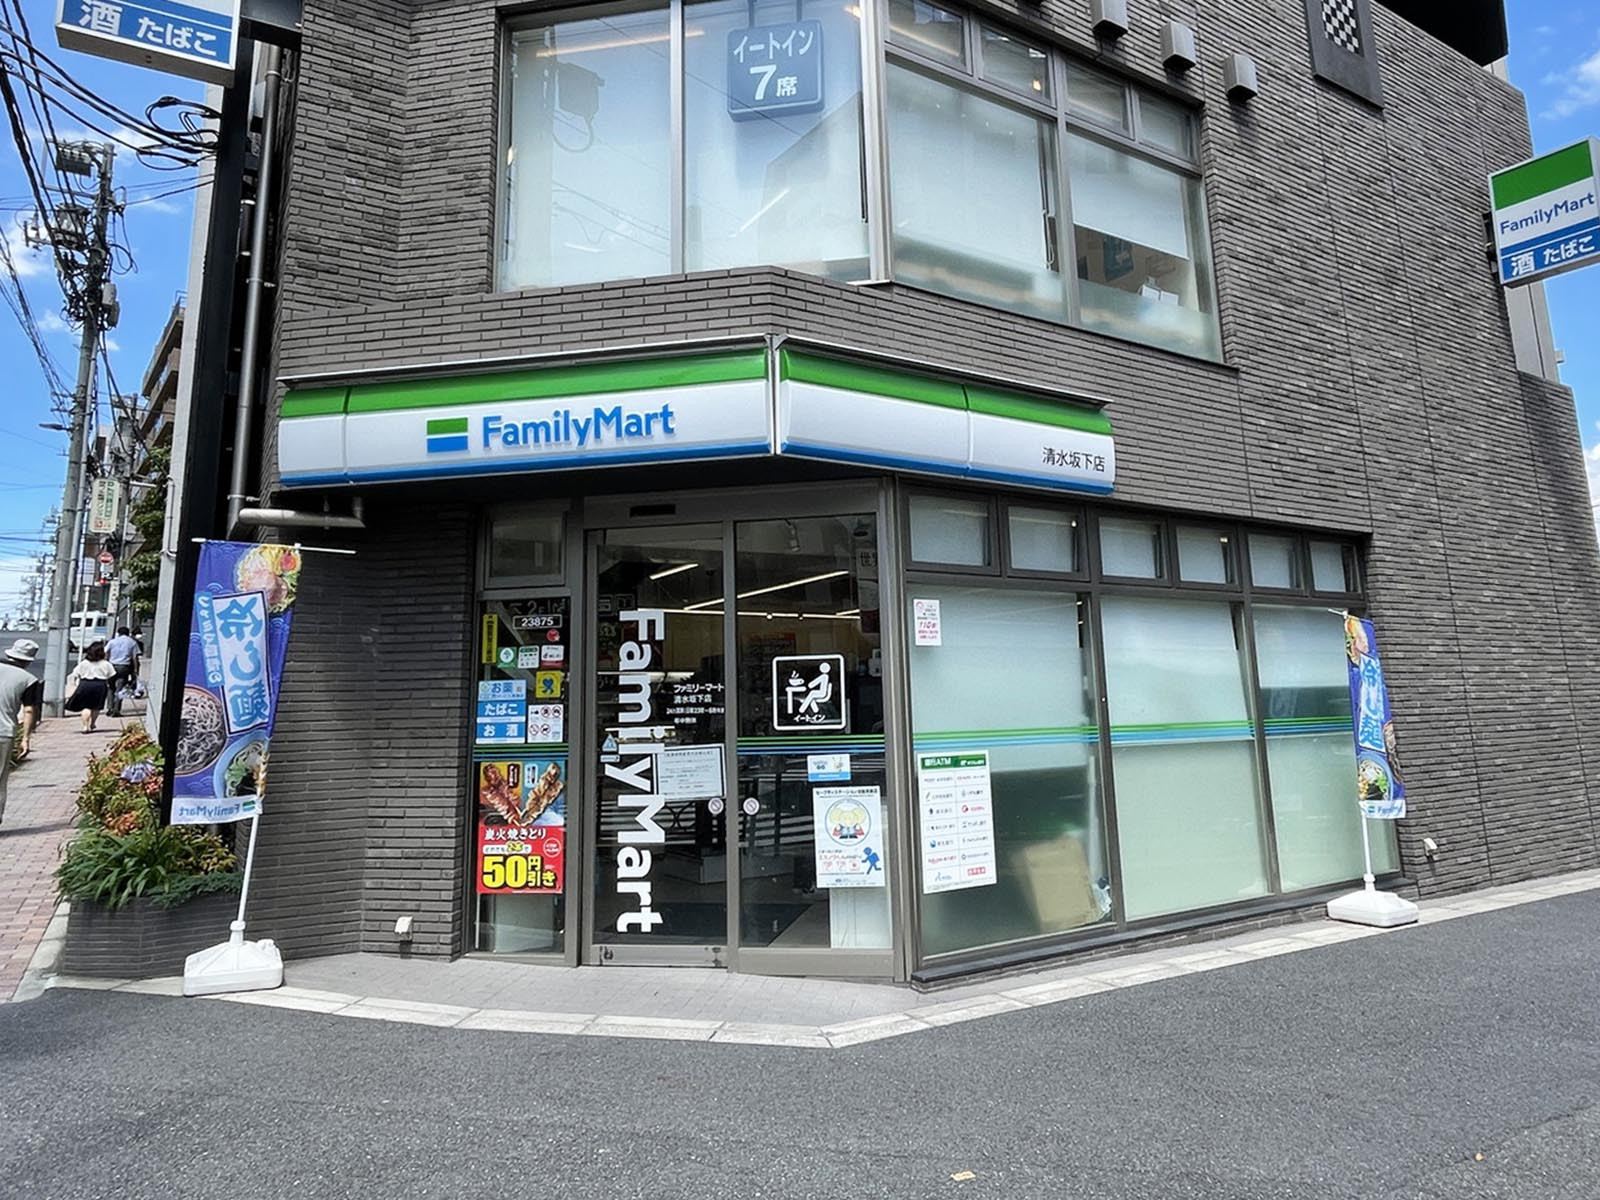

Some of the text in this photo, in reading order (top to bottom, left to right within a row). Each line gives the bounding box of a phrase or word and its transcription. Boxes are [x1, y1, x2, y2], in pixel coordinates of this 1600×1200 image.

[79, 0, 217, 56] 酒 たばこ
[733, 29, 814, 63] イートイン
[1500, 192, 1595, 235] FamilyMart
[1511, 235, 1595, 277] 酒 たばこ
[482, 403, 676, 448] FamilyMart
[1042, 447, 1106, 473] 清水坂下店
[521, 616, 554, 627] 23875
[673, 682, 724, 694] ファミリーマート
[484, 703, 518, 716] たばこ
[793, 714, 826, 723] イートイン
[605, 608, 666, 934] FamilyMart
